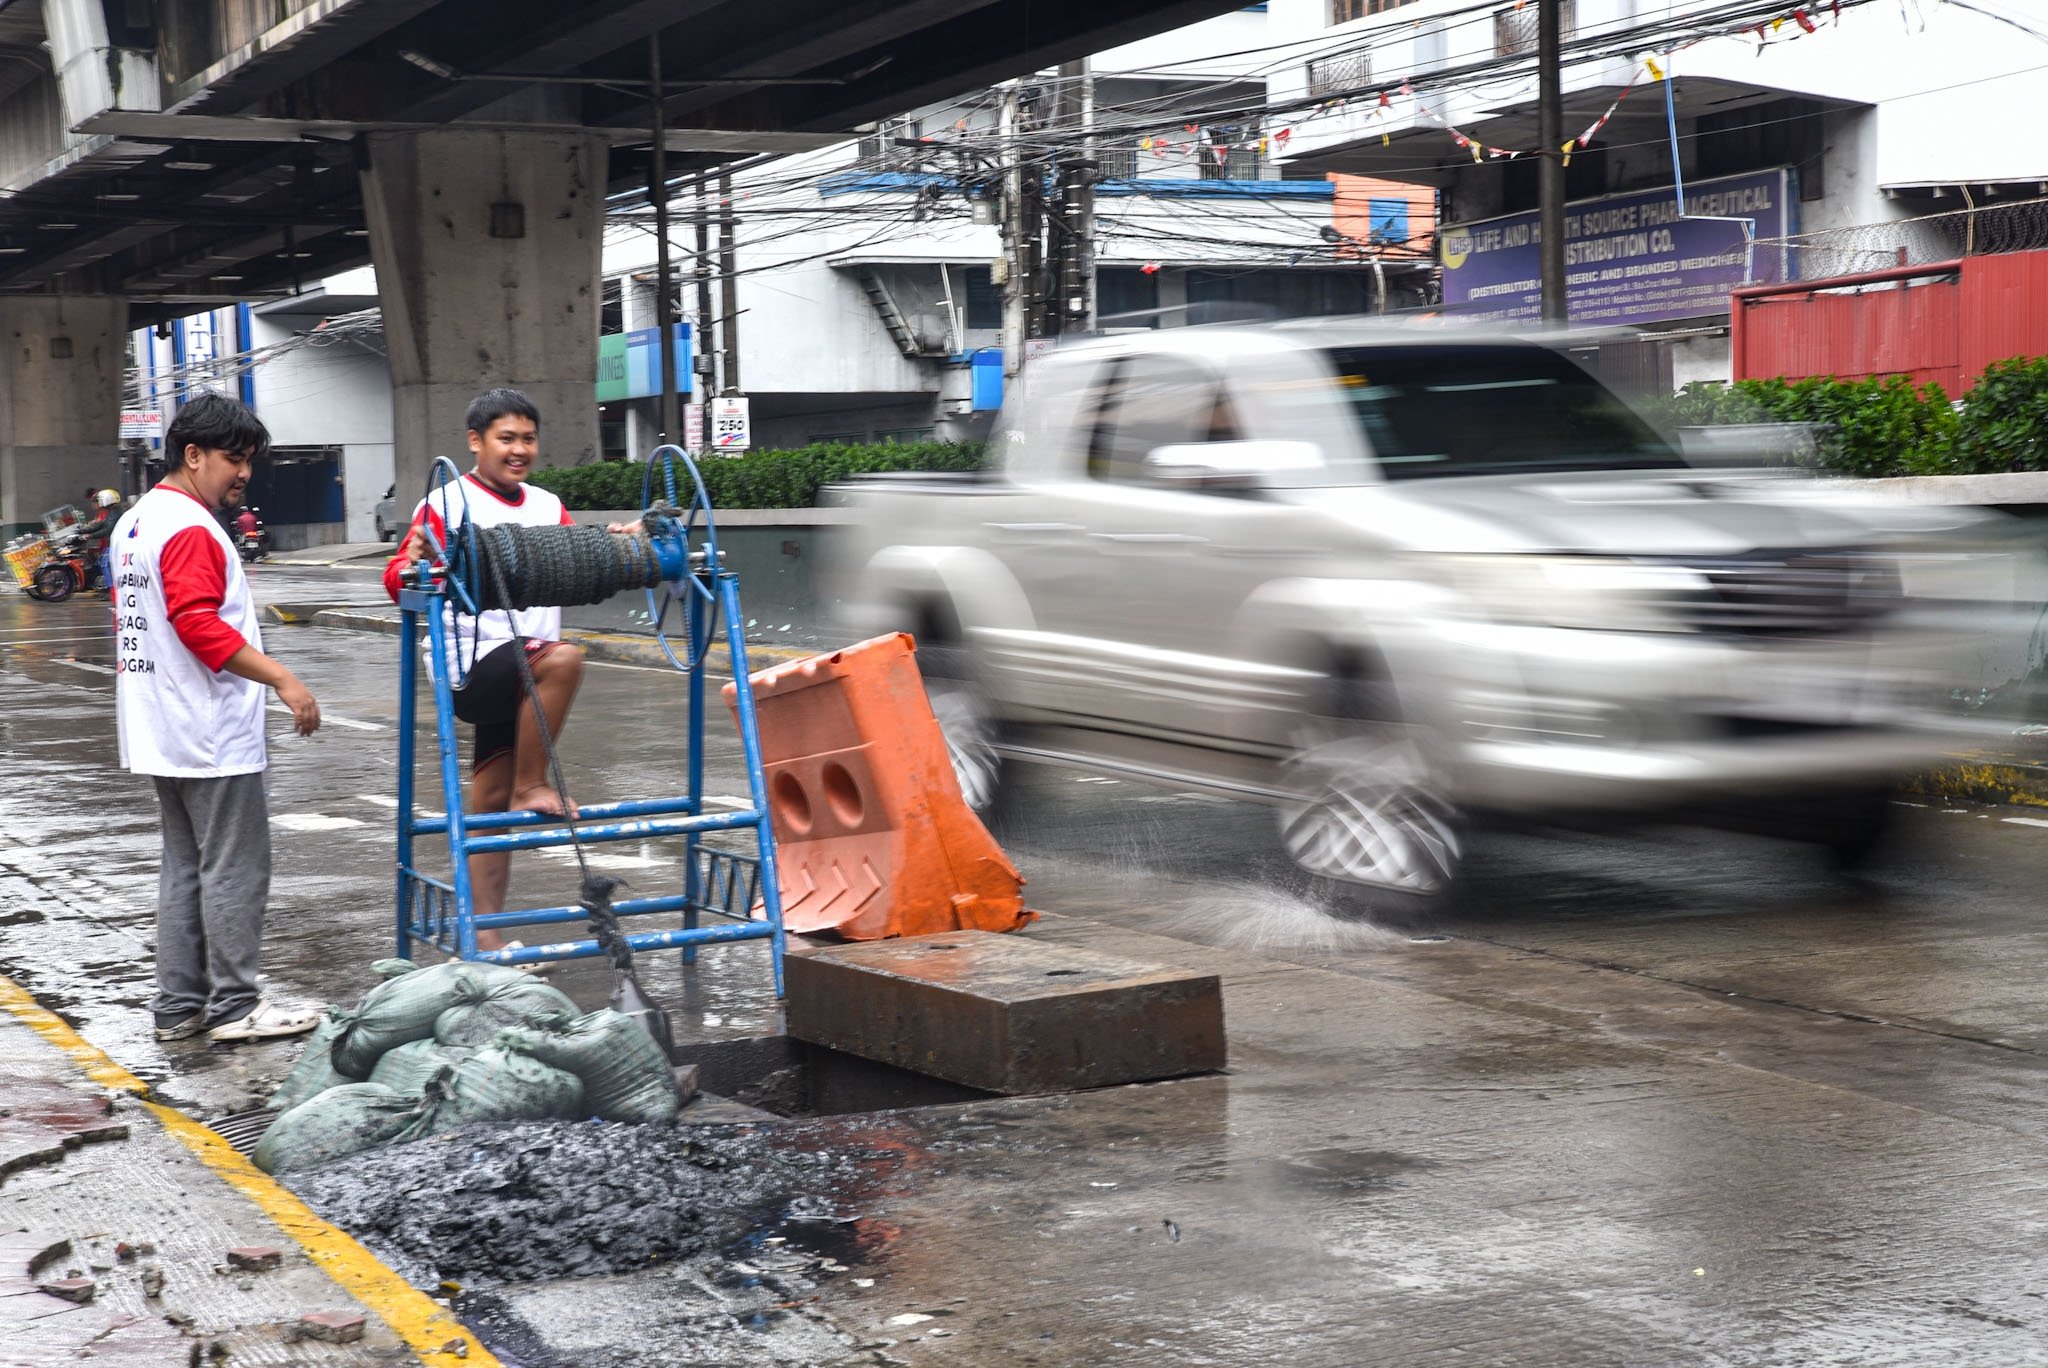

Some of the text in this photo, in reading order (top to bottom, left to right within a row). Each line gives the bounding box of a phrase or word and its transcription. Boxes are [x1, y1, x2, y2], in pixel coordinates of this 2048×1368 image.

[1475, 228, 1502, 253] LIFE
[1503, 223, 1530, 249] AND
[1583, 206, 1639, 235] SOURCE
[1563, 232, 1648, 266] ISTRIBUTION
[1564, 271, 1599, 286] NERIC
[1624, 260, 1679, 278] BRANDED
